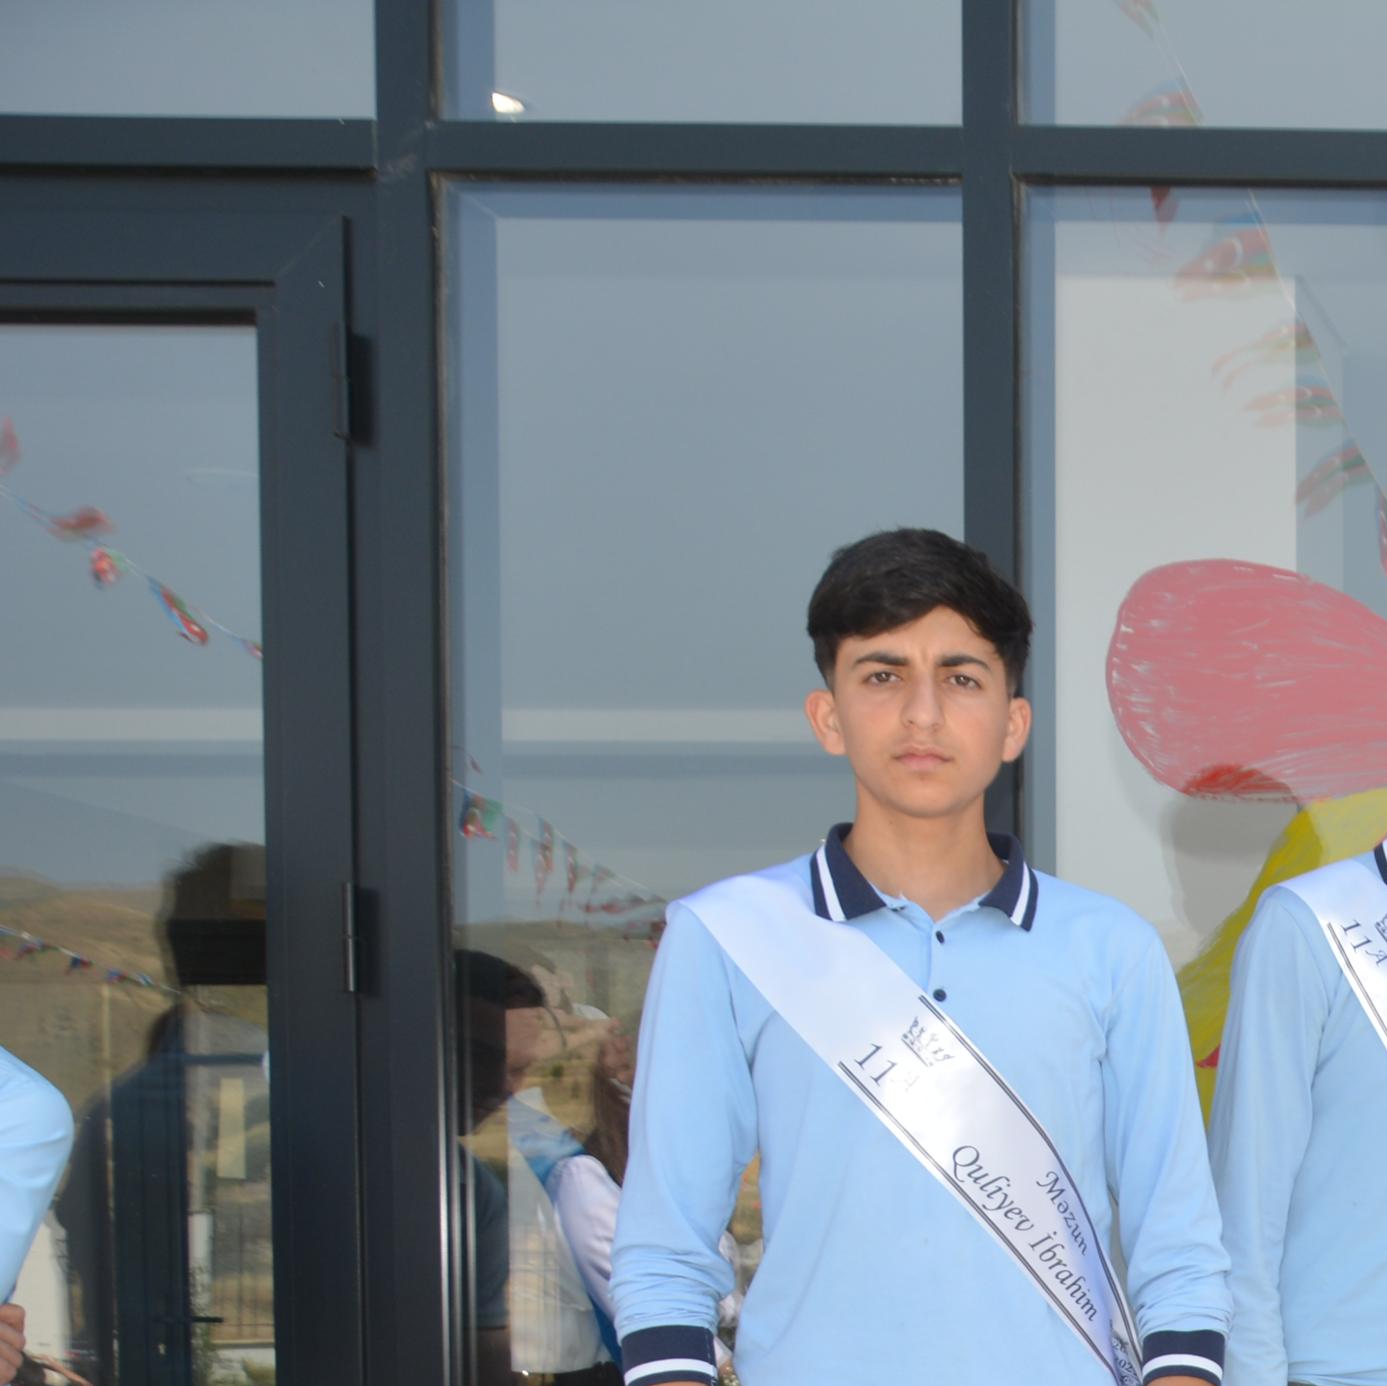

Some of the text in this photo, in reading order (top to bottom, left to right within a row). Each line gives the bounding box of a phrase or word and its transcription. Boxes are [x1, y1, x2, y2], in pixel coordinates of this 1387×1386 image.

[952, 1145, 1099, 1322] Quliyev İbrahim
[1036, 1171, 1089, 1257] Məzun
